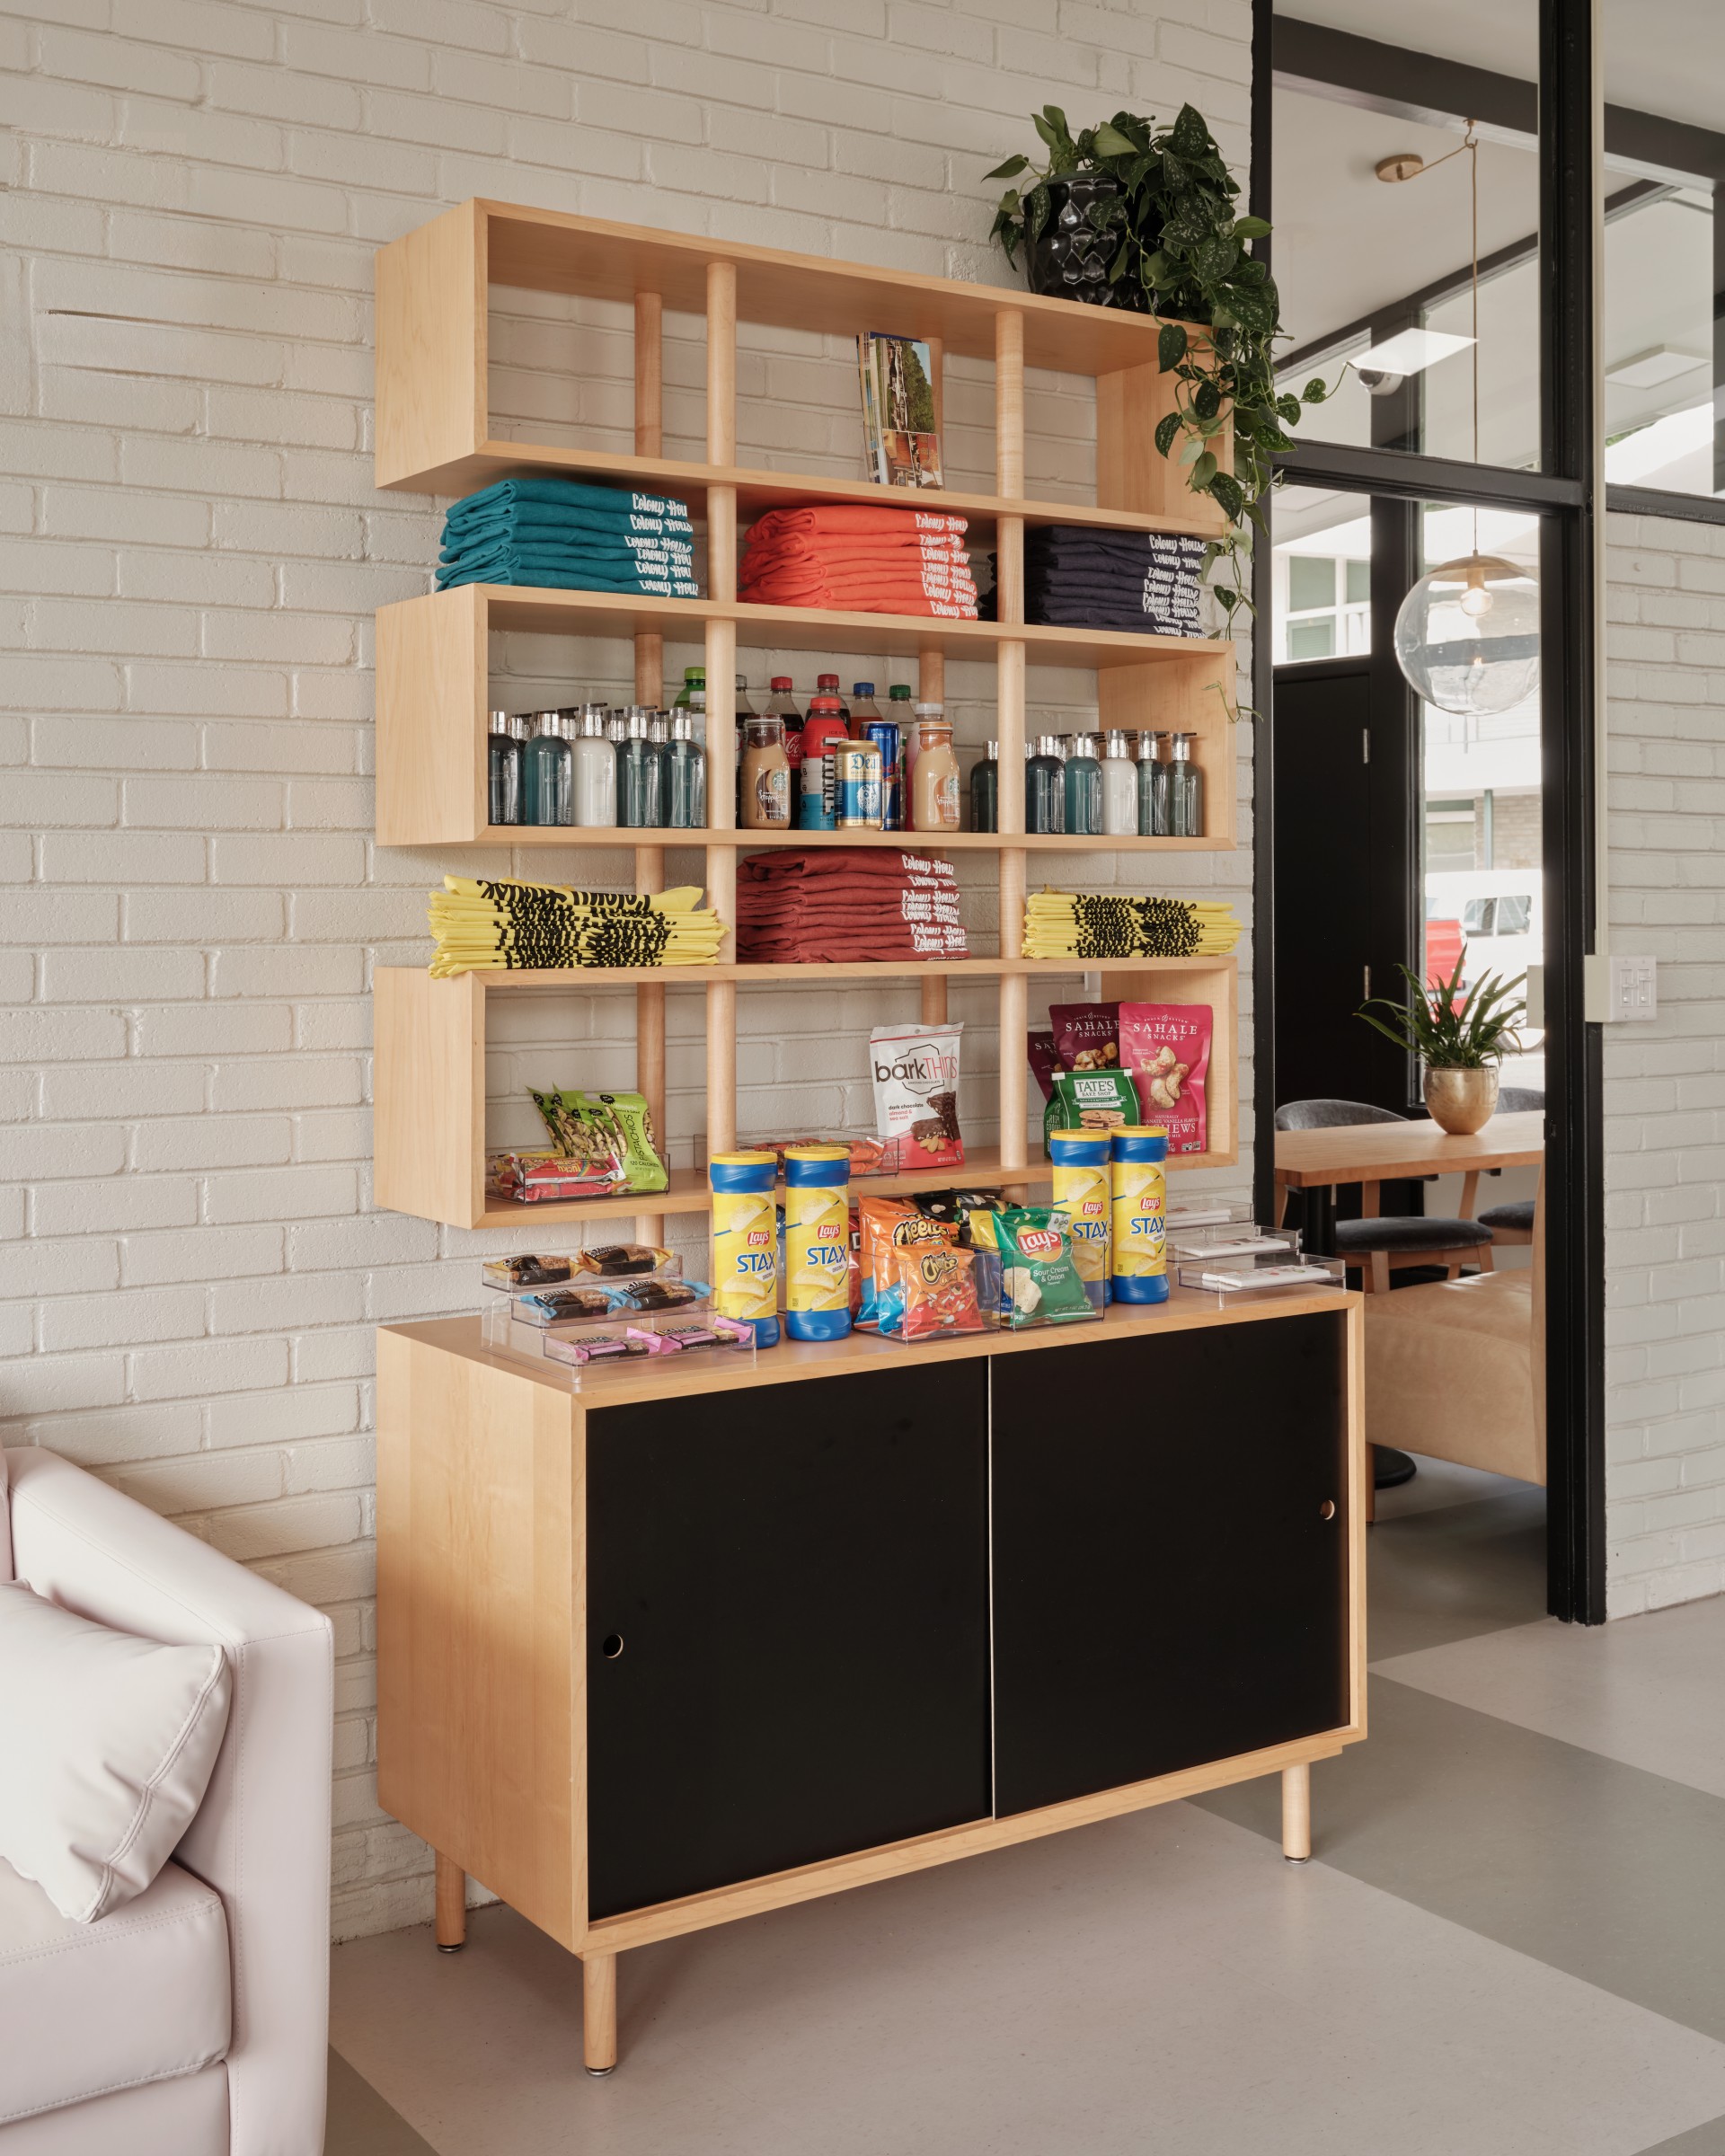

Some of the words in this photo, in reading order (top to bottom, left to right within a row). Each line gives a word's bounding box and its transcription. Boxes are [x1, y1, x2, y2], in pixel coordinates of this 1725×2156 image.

[632, 493, 664, 517] Colony
[630, 514, 663, 535] Colony
[916, 513, 945, 532] Colony
[1149, 535, 1177, 553] Colony
[1179, 537, 1208, 553] House
[636, 548, 668, 565] Colony
[920, 546, 949, 563] Colony
[634, 561, 668, 580] Colony
[923, 583, 951, 602] Colony
[1144, 579, 1171, 596] Colony
[1172, 584, 1199, 601] House
[930, 601, 960, 619] Colony
[1172, 606, 1199, 619] House
[902, 854, 931, 875] Colony
[1066, 1021, 1119, 1032] SAHALE
[1133, 1022, 1198, 1035] SAHALE
[1147, 1033, 1184, 1041] SNACKS
[1076, 1081, 1115, 1092] TATE'S
[624, 1114, 649, 1161] PISTACHIOS
[1084, 1202, 1102, 1215] Lay's
[1142, 1197, 1160, 1210] Lay's
[818, 1224, 840, 1239] Lay's
[1073, 1221, 1108, 1239] STAX
[1130, 1215, 1165, 1234] STAX
[749, 1231, 770, 1246] Lay's
[1019, 1231, 1059, 1254] Lay's
[737, 1250, 775, 1273] STAX
[807, 1244, 847, 1266] STAX
[1047, 1273, 1065, 1282] Onion
[1050, 1266, 1069, 1275] Cream
